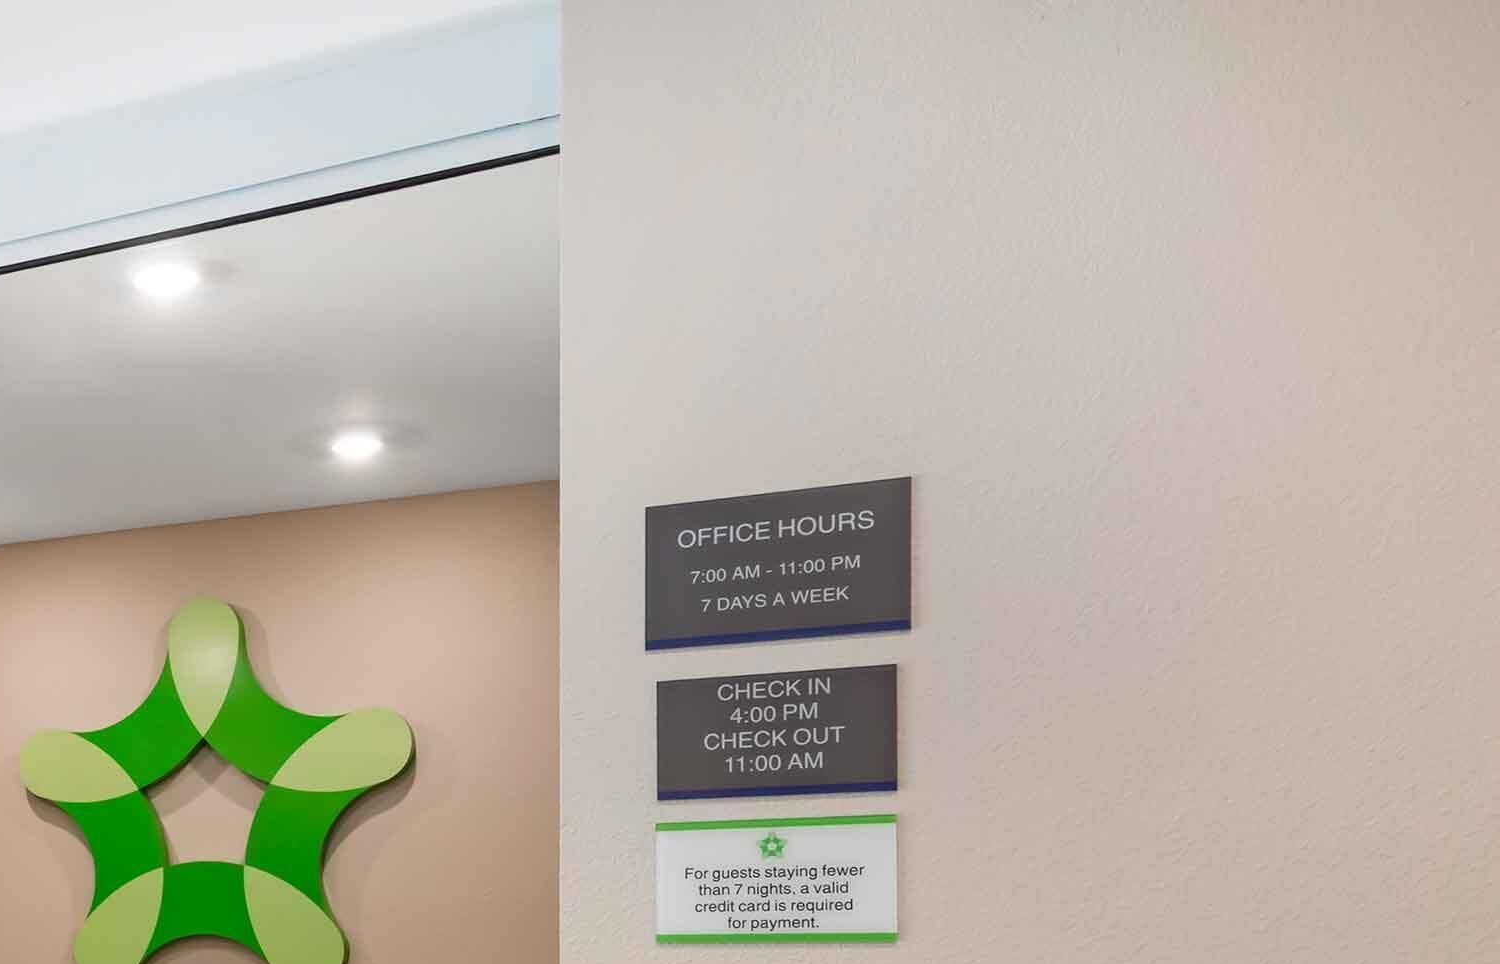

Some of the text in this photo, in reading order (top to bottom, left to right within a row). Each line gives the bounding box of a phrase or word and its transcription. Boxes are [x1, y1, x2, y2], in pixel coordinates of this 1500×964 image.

[677, 510, 875, 549] OFFICE HOURS
[691, 568, 726, 584] 7:00
[732, 564, 760, 581] AM
[779, 558, 825, 575] 11:00
[831, 554, 861, 570] PM
[701, 585, 849, 612] 7 DAYS A WEEK
[717, 677, 831, 701] CHECK IN
[730, 702, 819, 724] 4:00 PM
[704, 726, 846, 751] CHECK OUT
[725, 751, 823, 773] 11:00 AM
[684, 864, 865, 882] For guests staying fewer
[699, 884, 730, 896] than
[735, 884, 743, 895] 7
[800, 885, 810, 894] a
[814, 881, 849, 894] valid
[694, 899, 853, 914] credit card is required
[728, 916, 820, 932] for payment.
